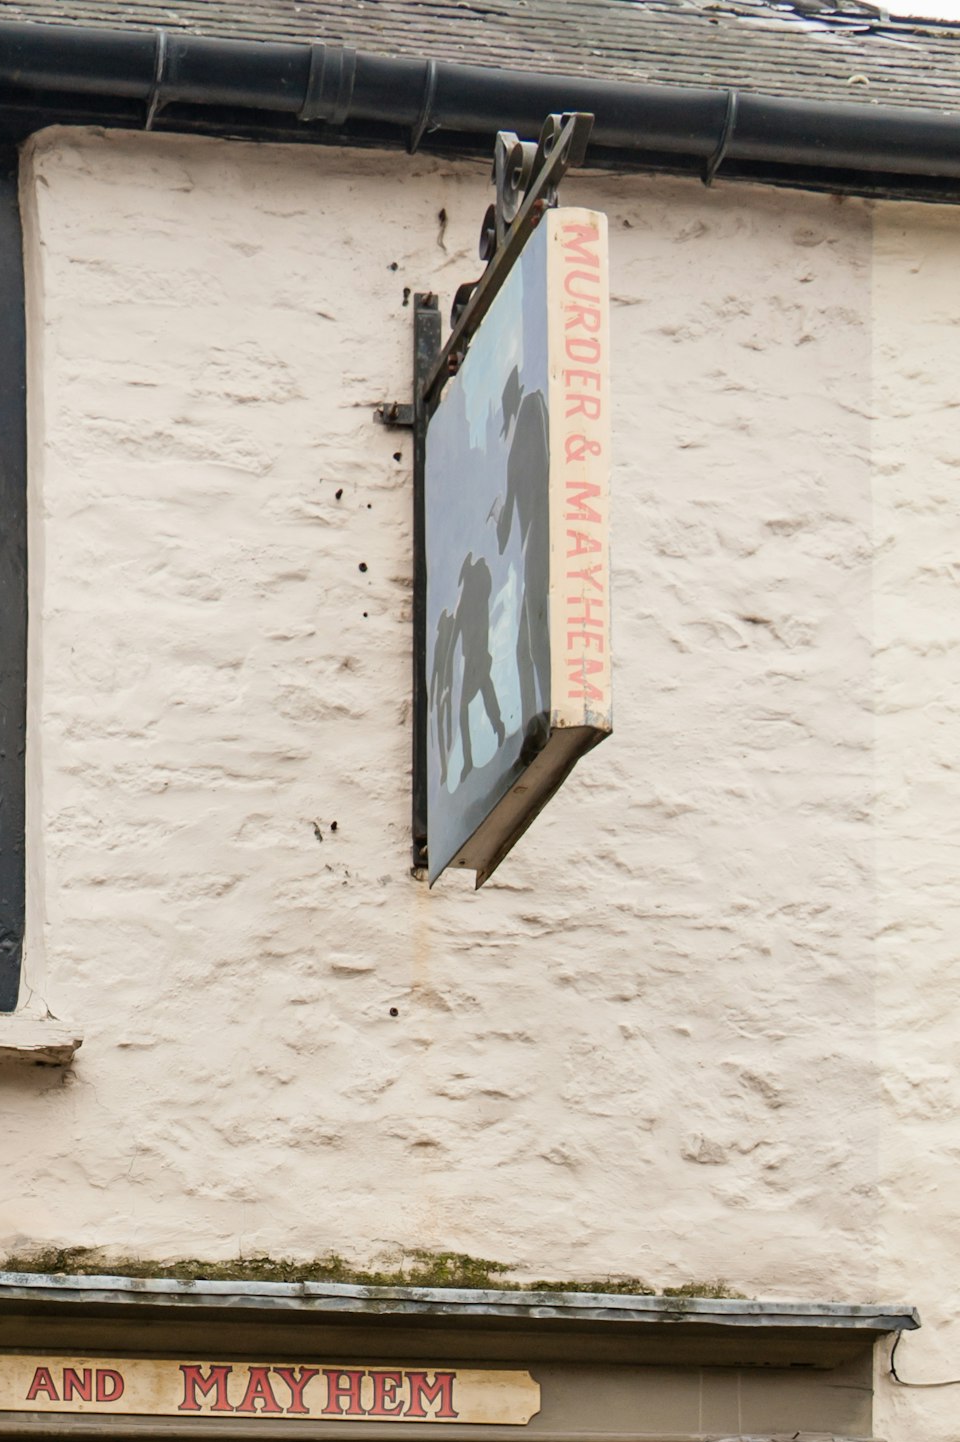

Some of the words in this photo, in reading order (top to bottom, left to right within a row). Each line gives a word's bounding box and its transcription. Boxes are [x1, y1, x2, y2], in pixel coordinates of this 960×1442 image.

[560, 221, 602, 424] MURDER
[565, 433, 601, 465] &
[566, 481, 604, 703] MAYHEM
[26, 1366, 124, 1402] AND
[178, 1363, 459, 1418] MAYHEM
